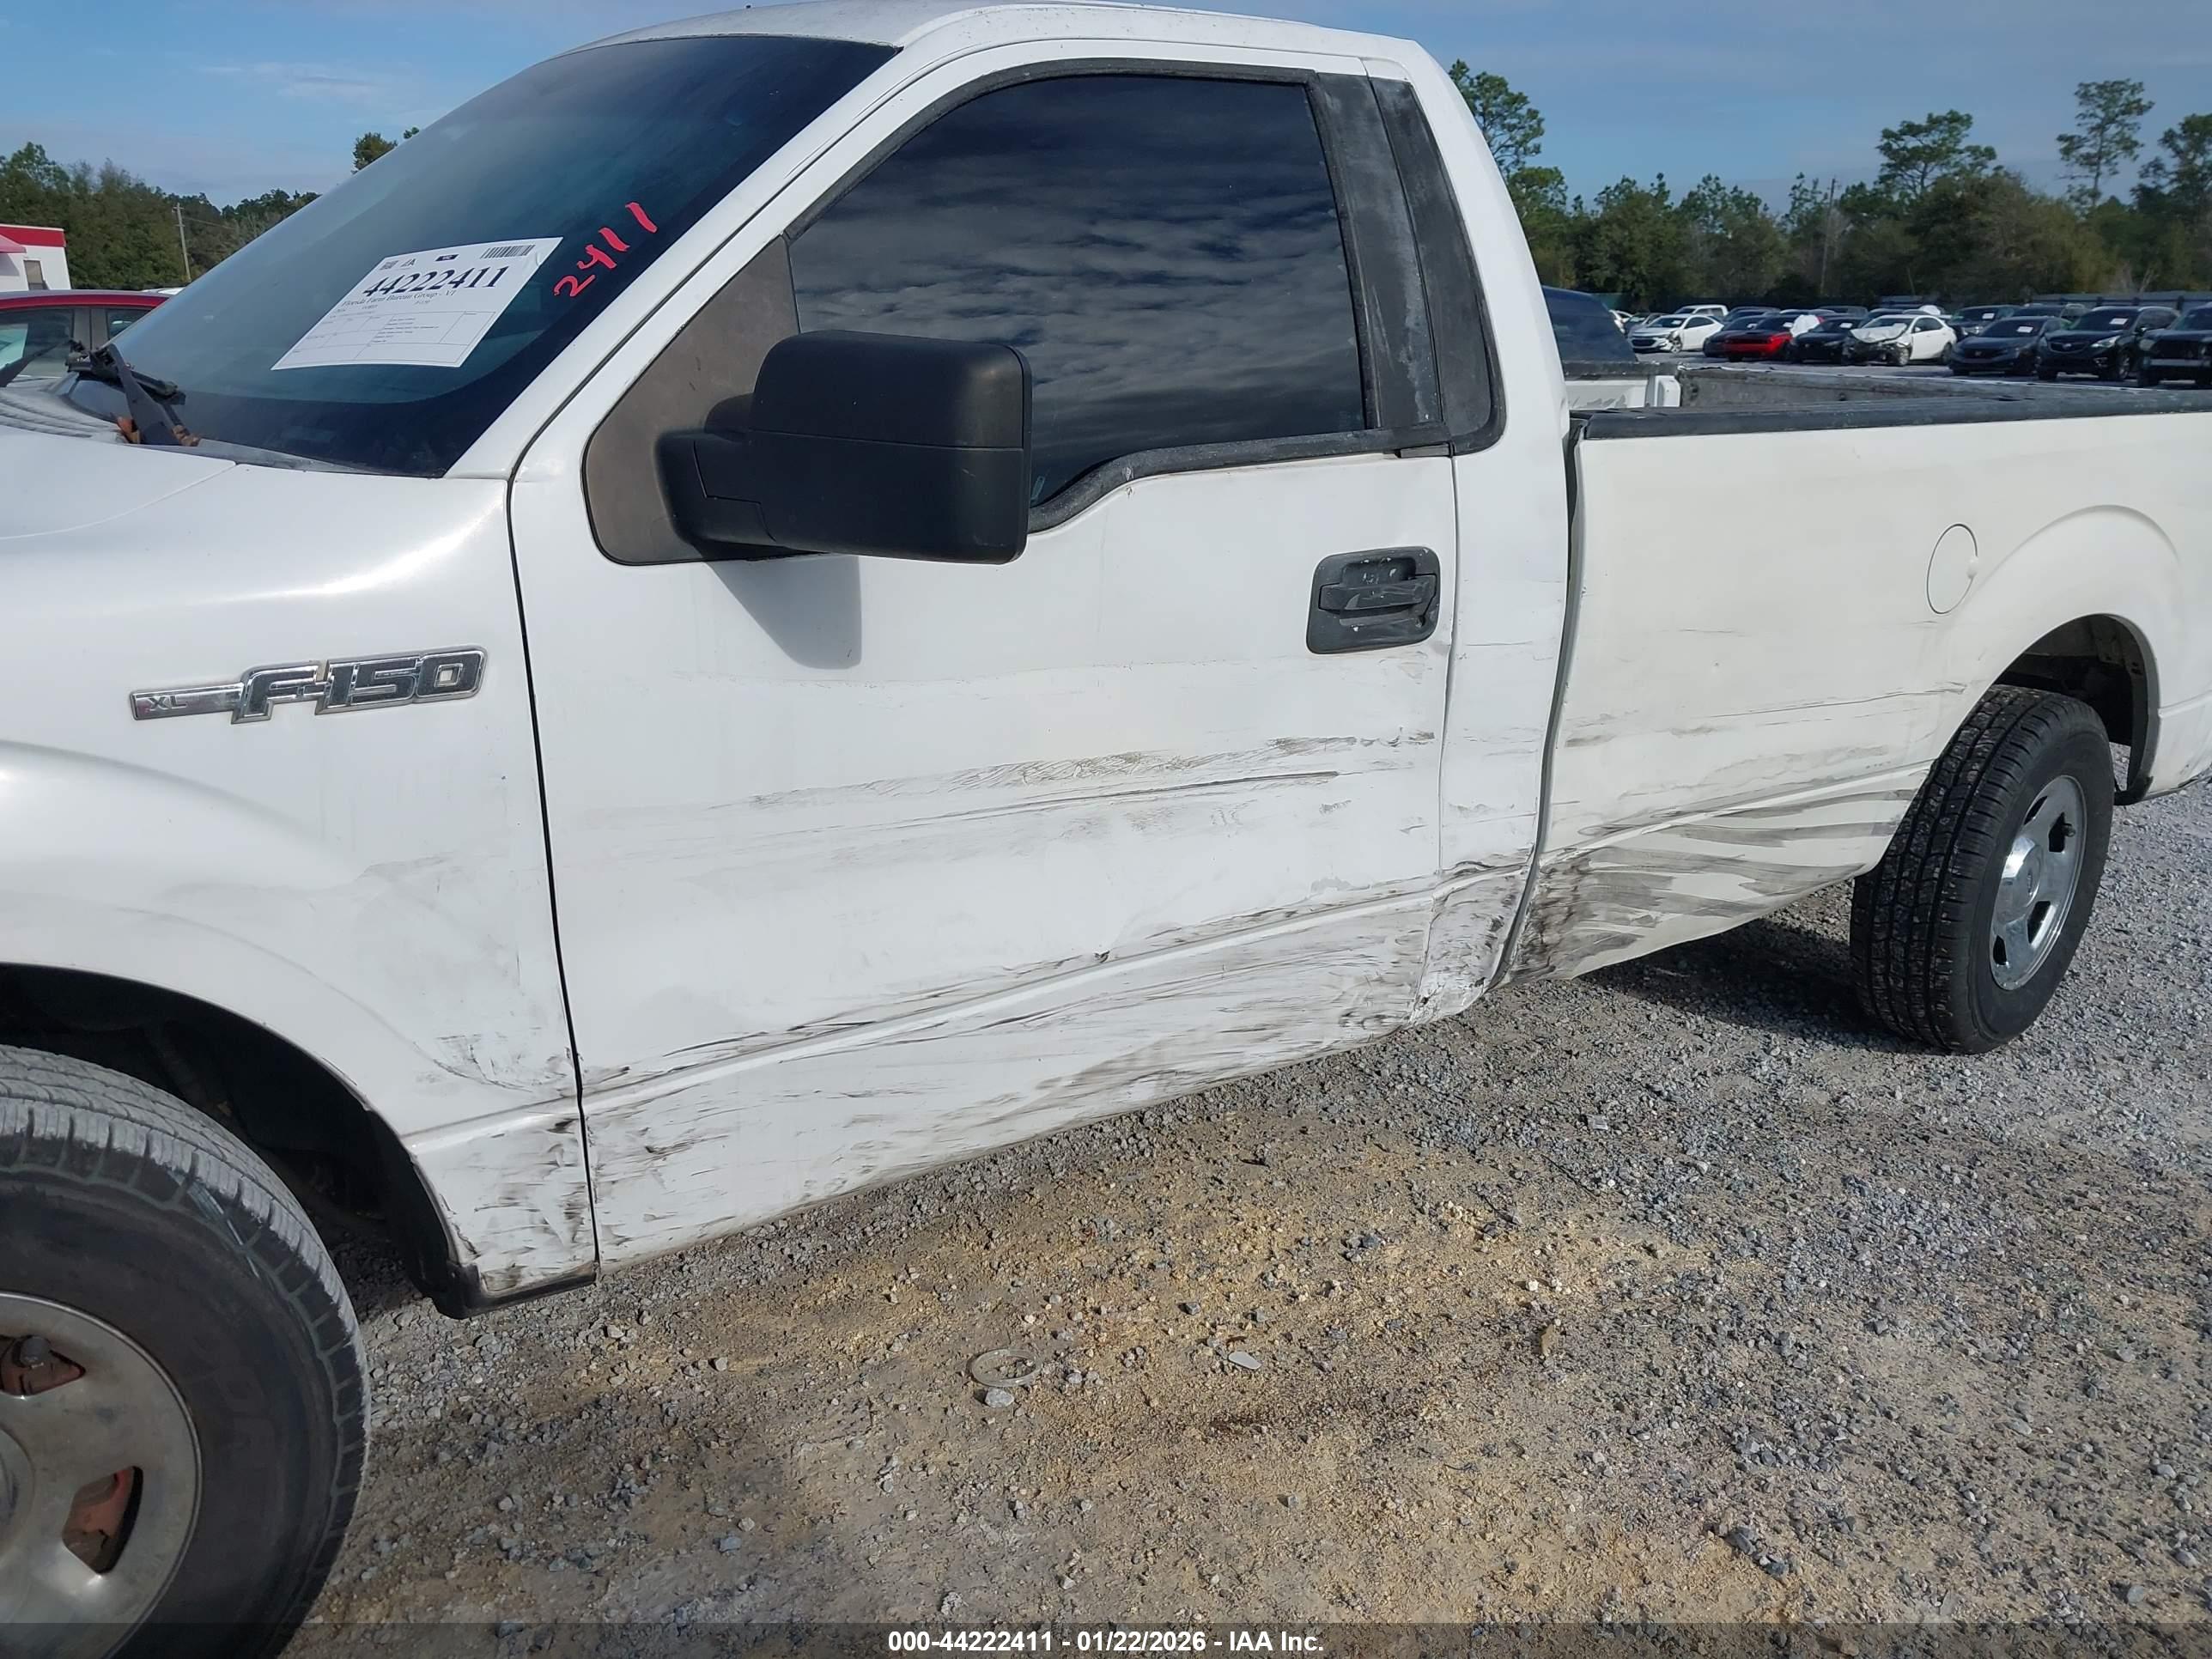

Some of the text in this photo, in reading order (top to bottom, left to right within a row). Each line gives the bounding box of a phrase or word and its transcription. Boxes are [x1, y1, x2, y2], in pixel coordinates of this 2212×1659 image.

[362, 266, 509, 297] 44222411
[554, 202, 658, 297] 2411
[147, 646, 488, 725] XL F-150
